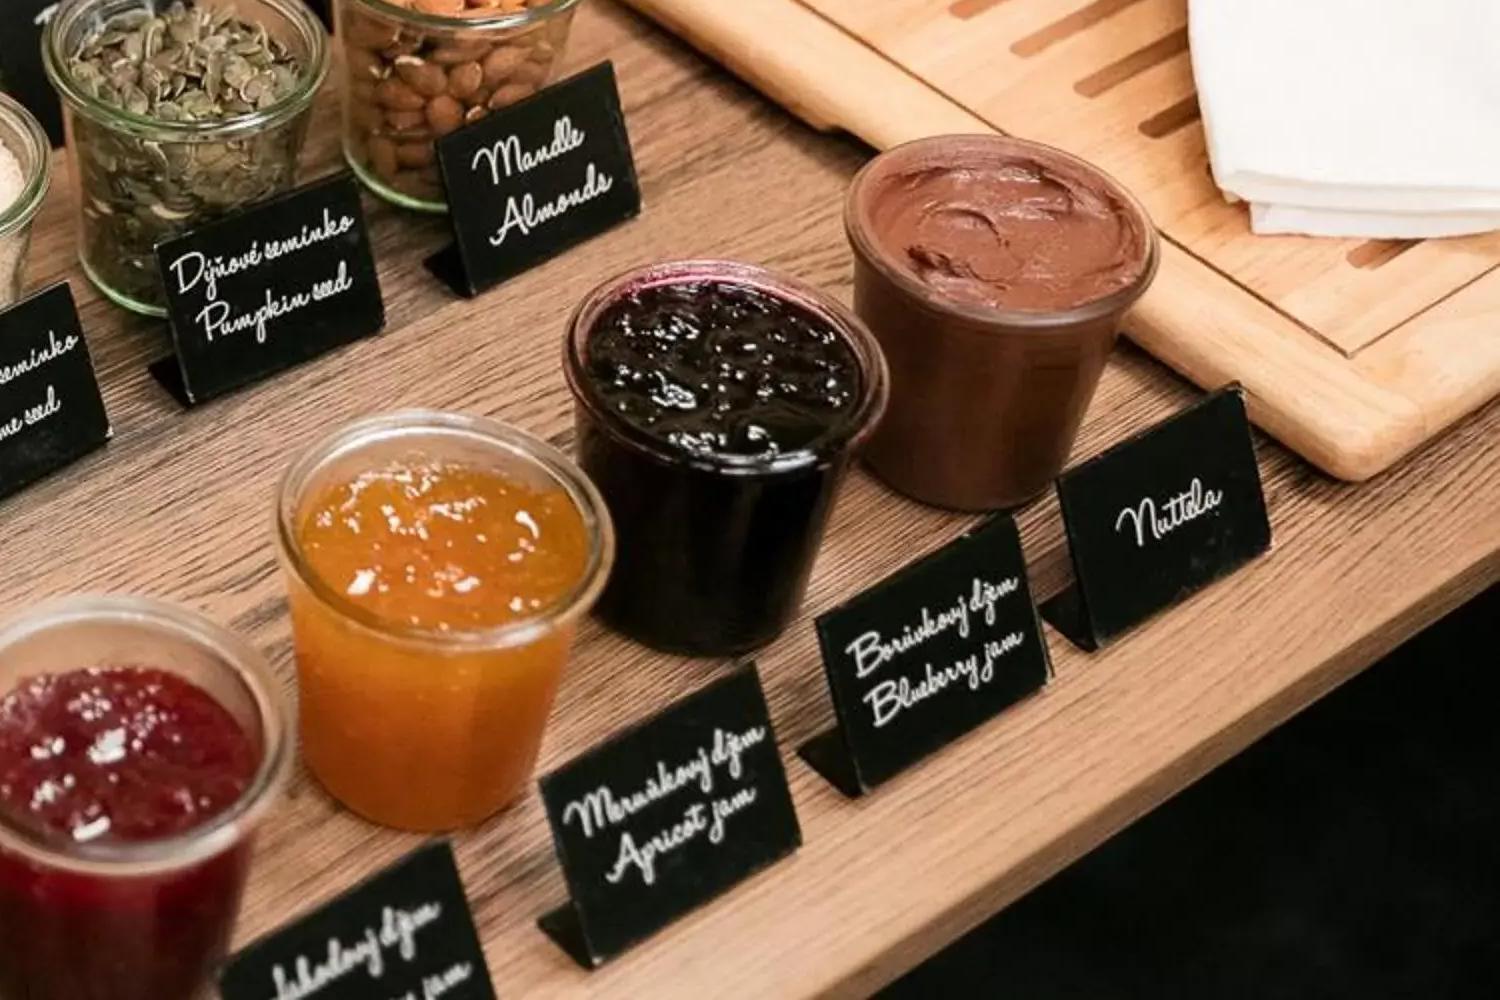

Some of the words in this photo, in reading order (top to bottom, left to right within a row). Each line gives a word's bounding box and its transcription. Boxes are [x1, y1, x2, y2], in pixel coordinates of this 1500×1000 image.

[471, 115, 585, 185] Mandle
[489, 162, 613, 246] Almonds
[169, 242, 263, 301] Dýňové
[264, 207, 355, 260] semínko
[195, 288, 311, 343] Pumpkin
[312, 260, 354, 301] seed
[24, 385, 61, 425] seed
[863, 653, 978, 728] Blueberry
[980, 631, 1025, 683] jam
[605, 803, 706, 886] Apricot
[708, 788, 757, 844] jam
